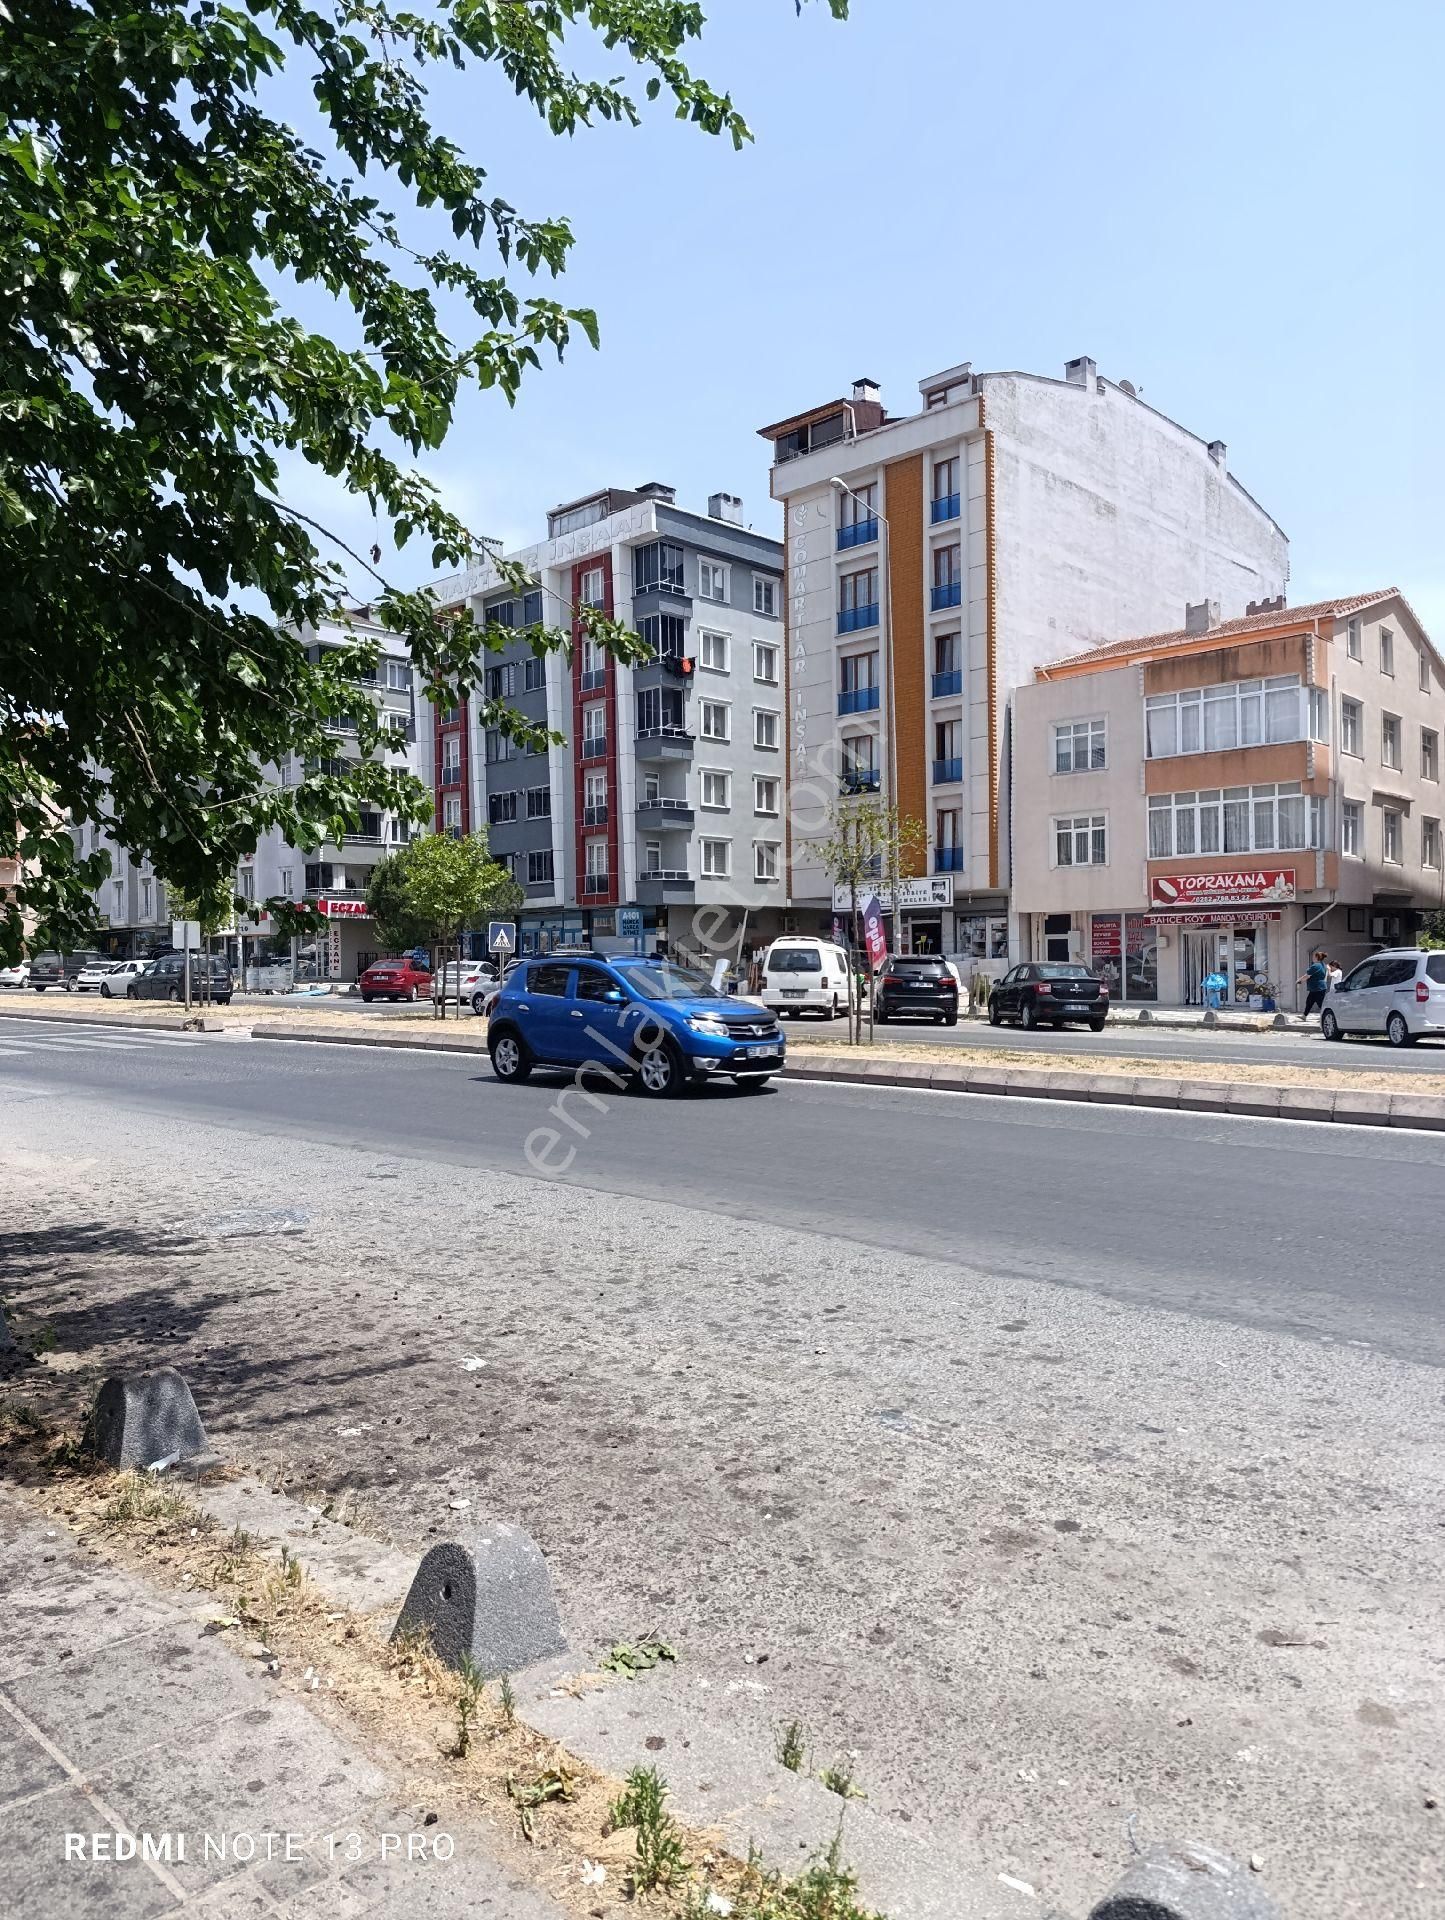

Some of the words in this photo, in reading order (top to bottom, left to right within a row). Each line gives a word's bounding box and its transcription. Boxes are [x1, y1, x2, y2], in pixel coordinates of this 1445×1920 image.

[1177, 873, 1267, 889] TOPRAKANA
[331, 902, 368, 914] ECZAN
[622, 911, 639, 920] A101
[1210, 914, 1236, 922] MANDA
